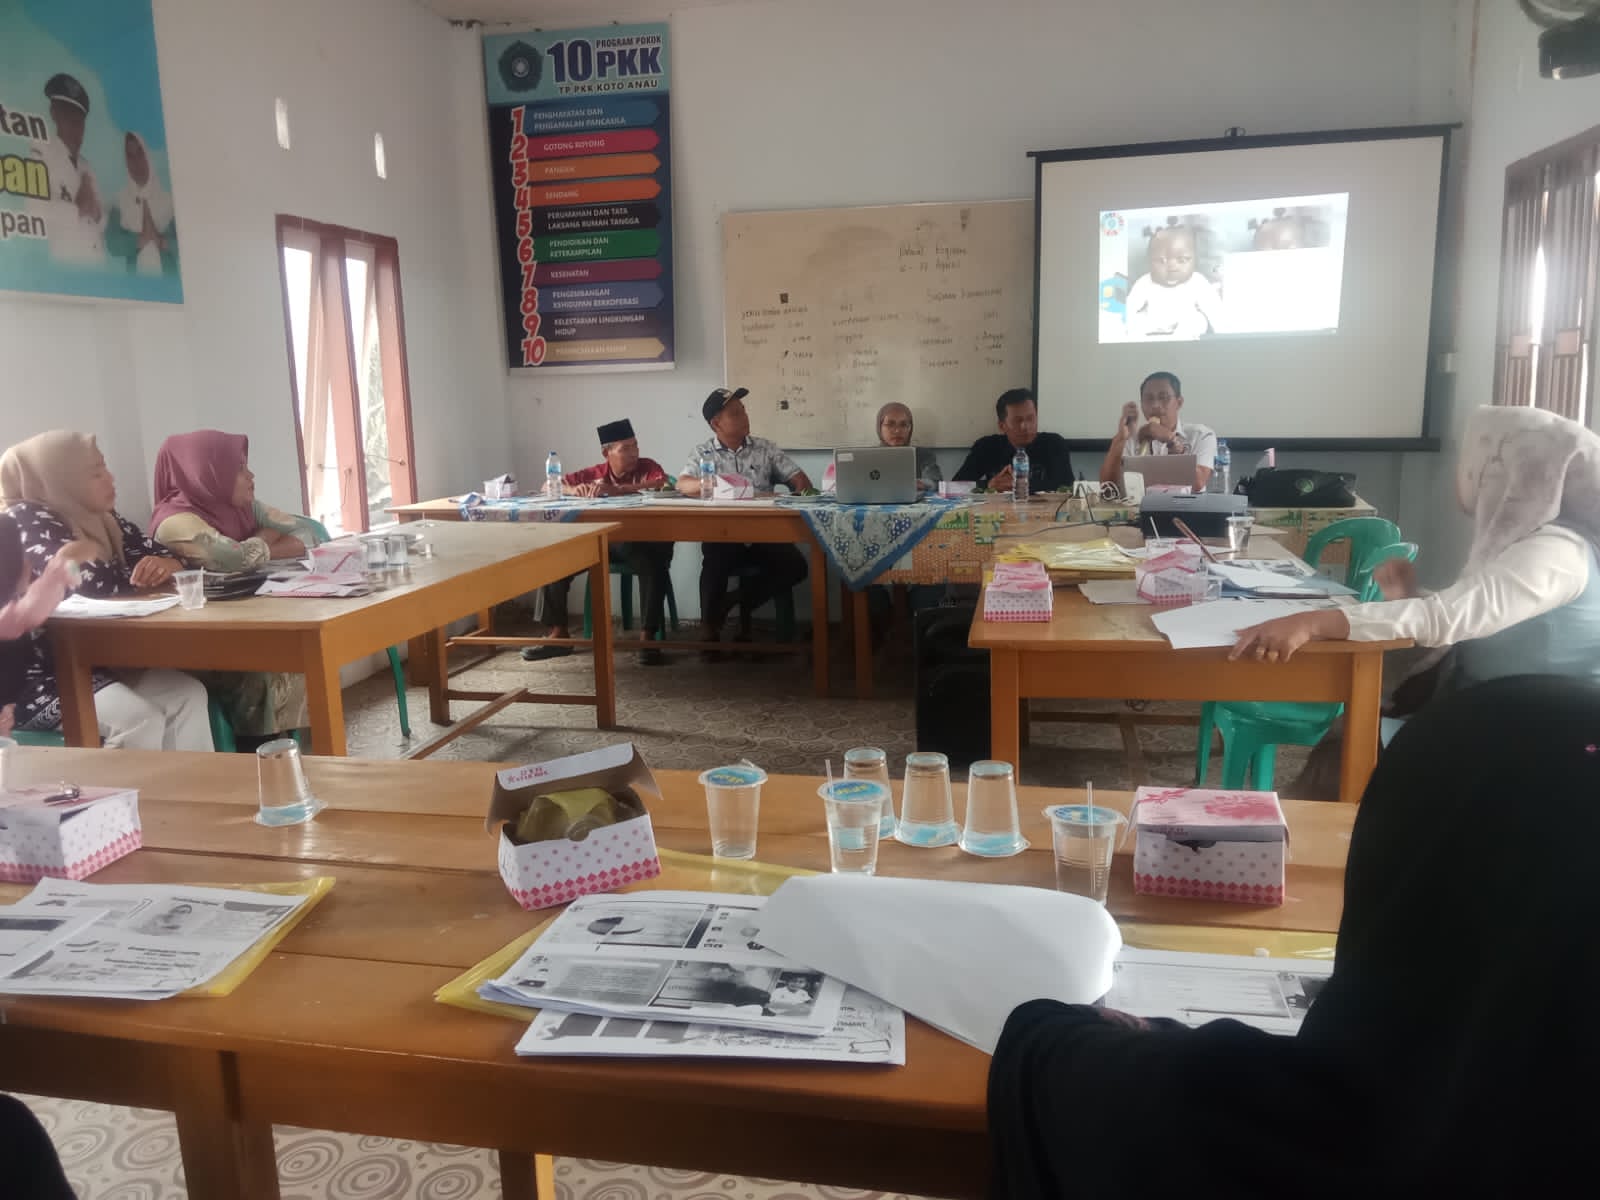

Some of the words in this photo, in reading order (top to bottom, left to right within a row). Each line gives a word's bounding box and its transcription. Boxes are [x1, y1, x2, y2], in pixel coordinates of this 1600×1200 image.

[596, 37, 633, 48] PROGRAM
[636, 35, 661, 46] POKOK
[547, 39, 592, 82] 10
[597, 47, 661, 77] PKK
[559, 85, 571, 94] TP
[574, 84, 593, 93] PKK
[597, 82, 624, 92] KOTO
[627, 80, 658, 89] ANAU
[511, 105, 525, 136] 1
[534, 109, 585, 120] PENGHAYATAN
[587, 107, 604, 116] DAN
[534, 121, 585, 131] PENGAMALAN
[586, 117, 626, 127] PANCASILA
[511, 134, 528, 162] 2
[543, 143, 574, 152] GOTONG
[575, 139, 606, 148] ROYONG
[512, 160, 529, 187] 3
[514, 186, 531, 210] 4
[547, 209, 592, 219] PERUMAHAN
[594, 207, 609, 217] DAN
[611, 207, 628, 215] TATA
[516, 209, 532, 237] 5
[548, 220, 581, 230] LAKSANA
[582, 218, 609, 227] RUMAH
[610, 216, 640, 225] TANGGA
[517, 236, 534, 262] 6
[549, 238, 592, 248] PENDIDIKAN
[593, 236, 609, 245] DAN
[550, 247, 602, 257] KETERAMPILAN
[521, 261, 537, 289] 7
[550, 269, 590, 279] KESEHATAN
[552, 288, 610, 298] PENGEMBANGAN
[520, 287, 539, 314] 8
[522, 313, 541, 338] 9
[554, 316, 598, 326] KELESTARIAN
[599, 313, 645, 324] LINGKUNGAN
[555, 328, 577, 337] HIDUP
[521, 336, 547, 366] 10
